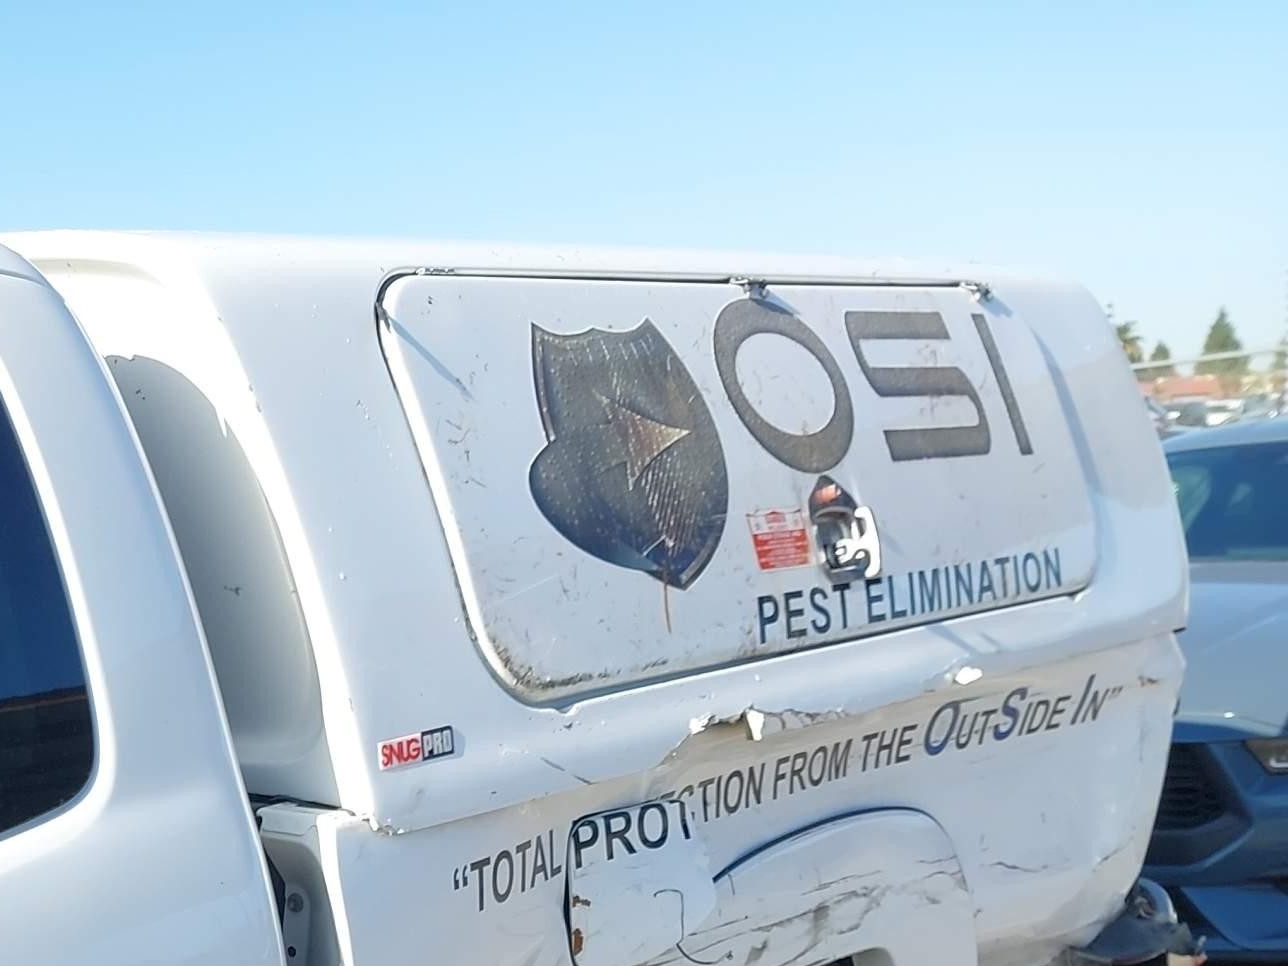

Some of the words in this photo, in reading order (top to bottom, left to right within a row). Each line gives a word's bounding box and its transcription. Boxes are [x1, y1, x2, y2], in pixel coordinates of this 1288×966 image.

[713, 297, 1033, 474] OSI
[757, 582, 851, 645] PEST
[865, 547, 1062, 625] ELIMINATION
[772, 738, 854, 800] FROM
[862, 724, 918, 772] THE
